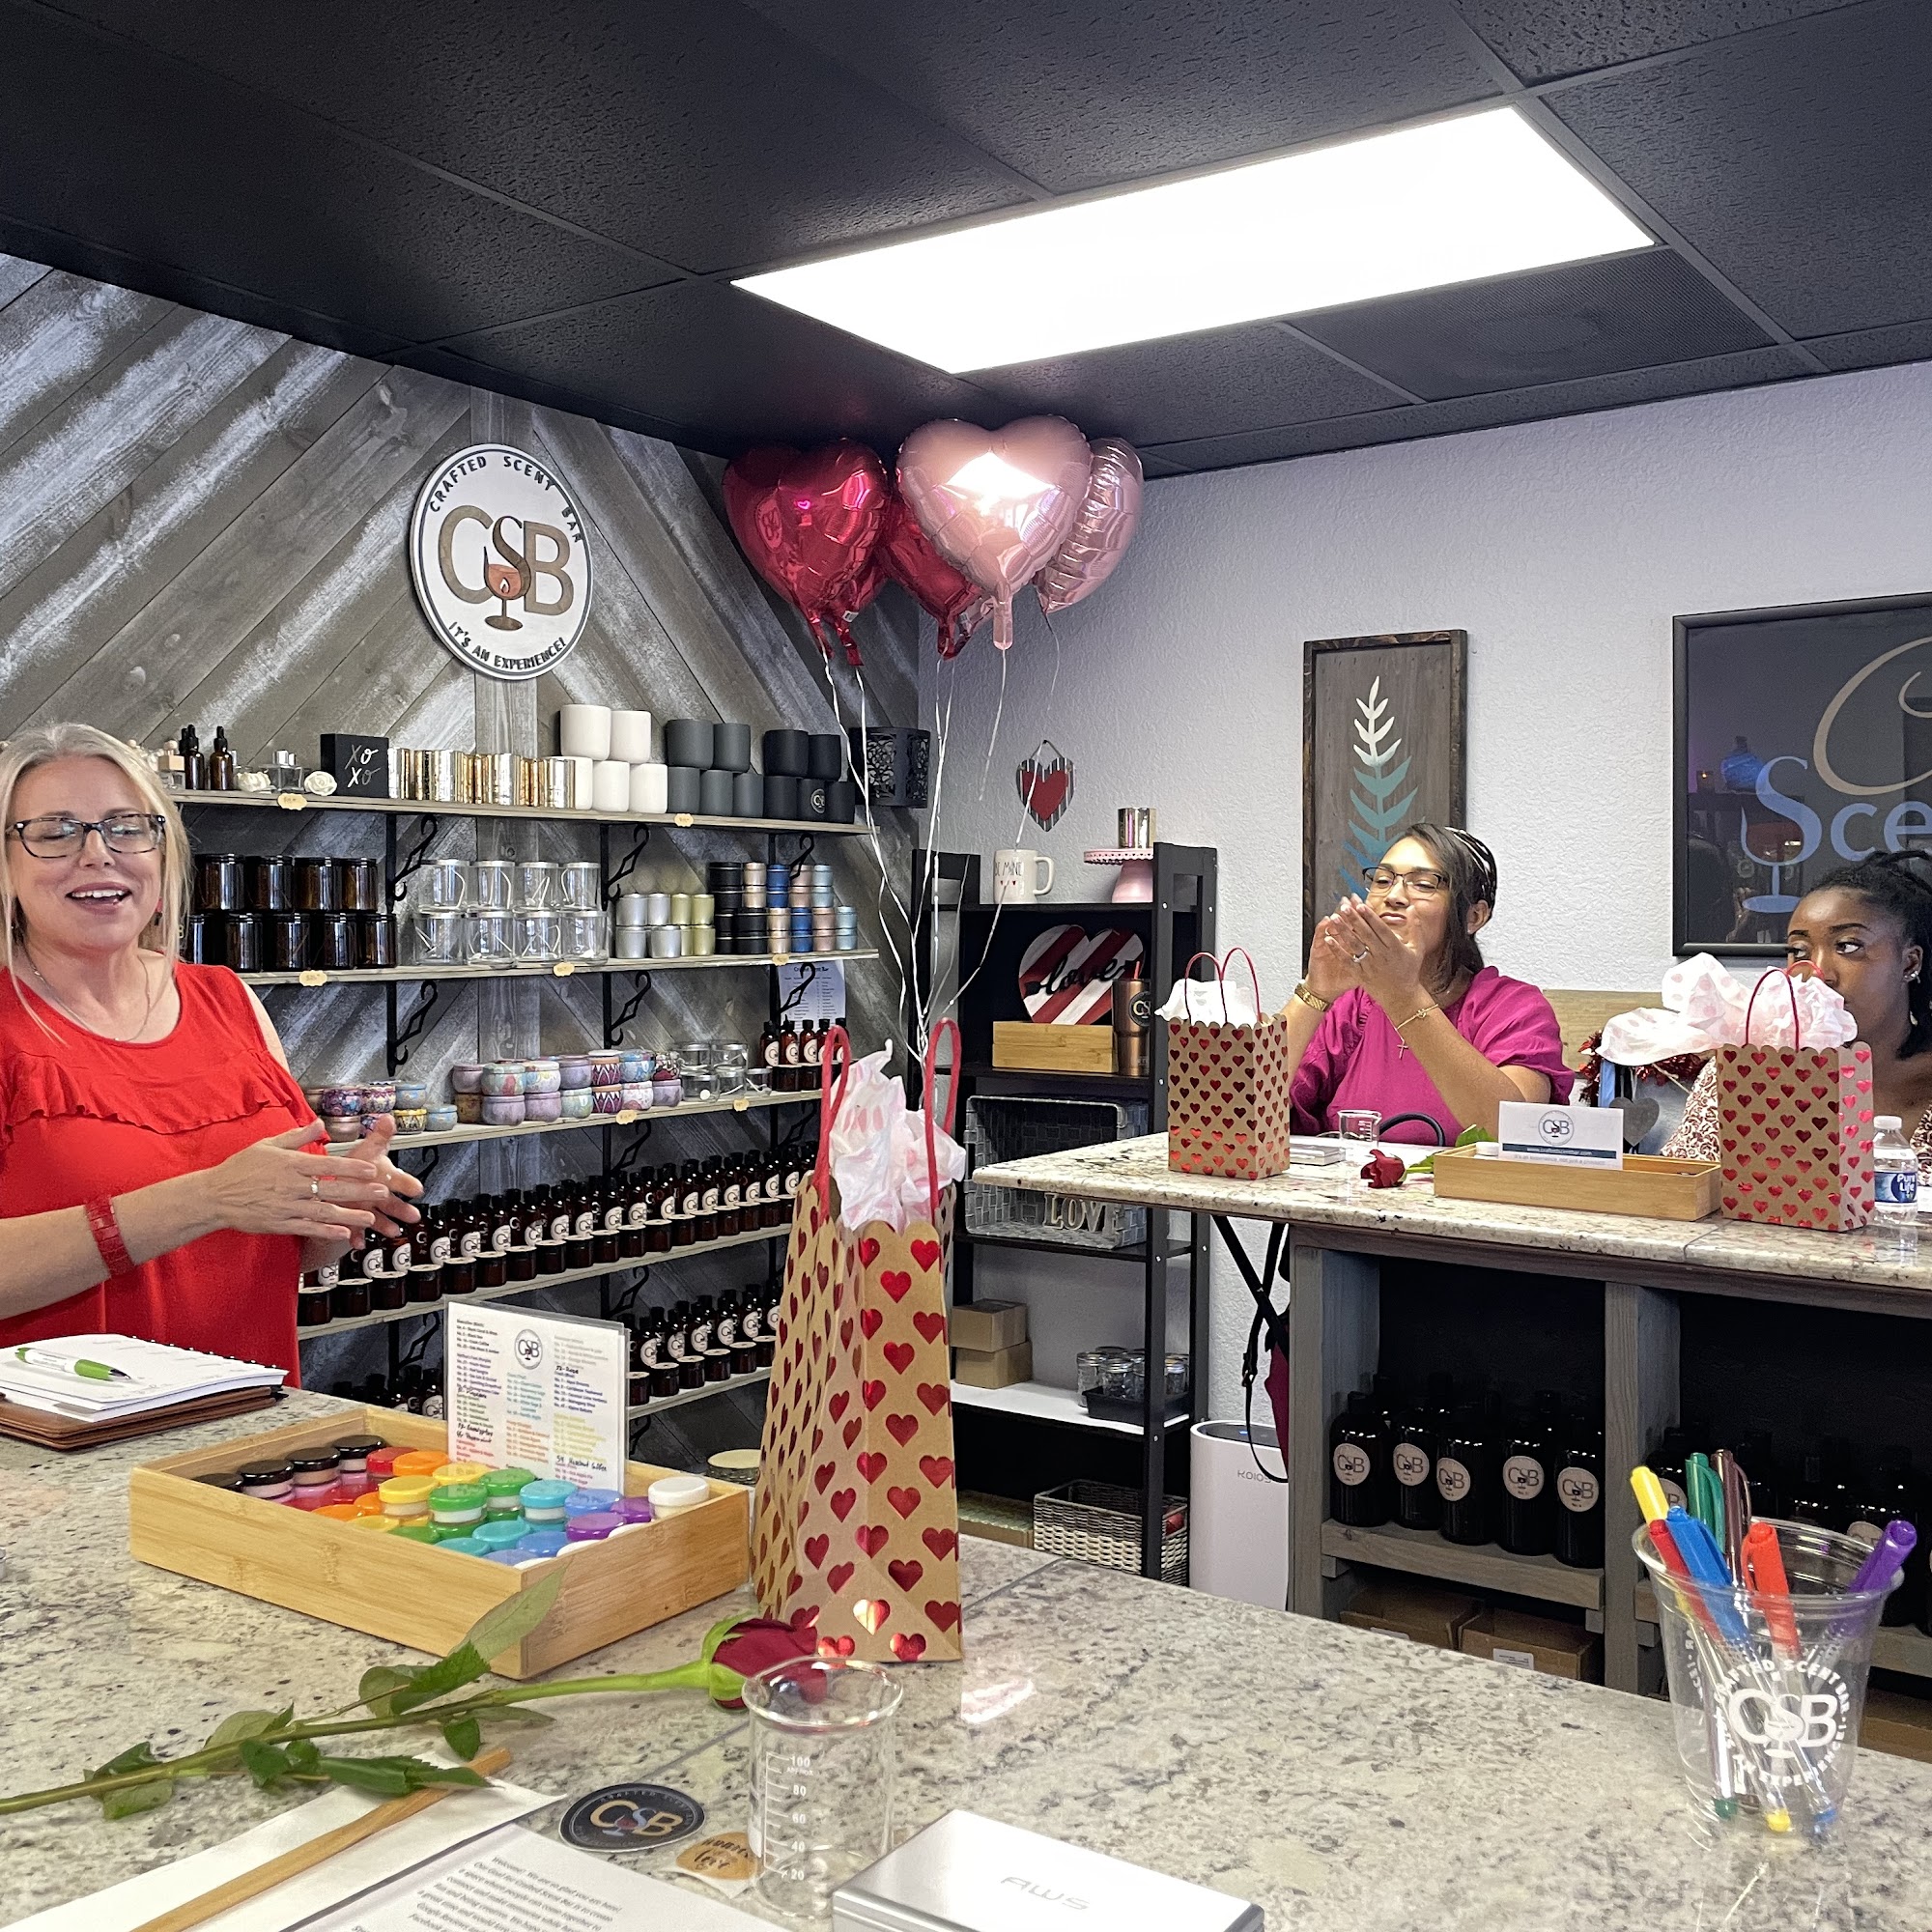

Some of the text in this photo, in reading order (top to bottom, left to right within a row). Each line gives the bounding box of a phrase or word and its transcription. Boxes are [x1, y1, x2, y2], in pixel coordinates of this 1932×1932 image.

[430, 455, 584, 544] CRAFTED SCENT BAR
[439, 504, 575, 618] CSB
[448, 621, 567, 670] IT'S AN EXPERIENCE!
[1507, 1466, 1541, 1487] CSB
[1561, 1478, 1596, 1499] CSB
[1728, 1688, 1838, 1748] CSB
[792, 1754, 811, 1768] 100
[793, 1784, 808, 1797] 80
[590, 1799, 684, 1836] CSB
[792, 1812, 807, 1825] 60
[790, 1868, 806, 1881] 20
